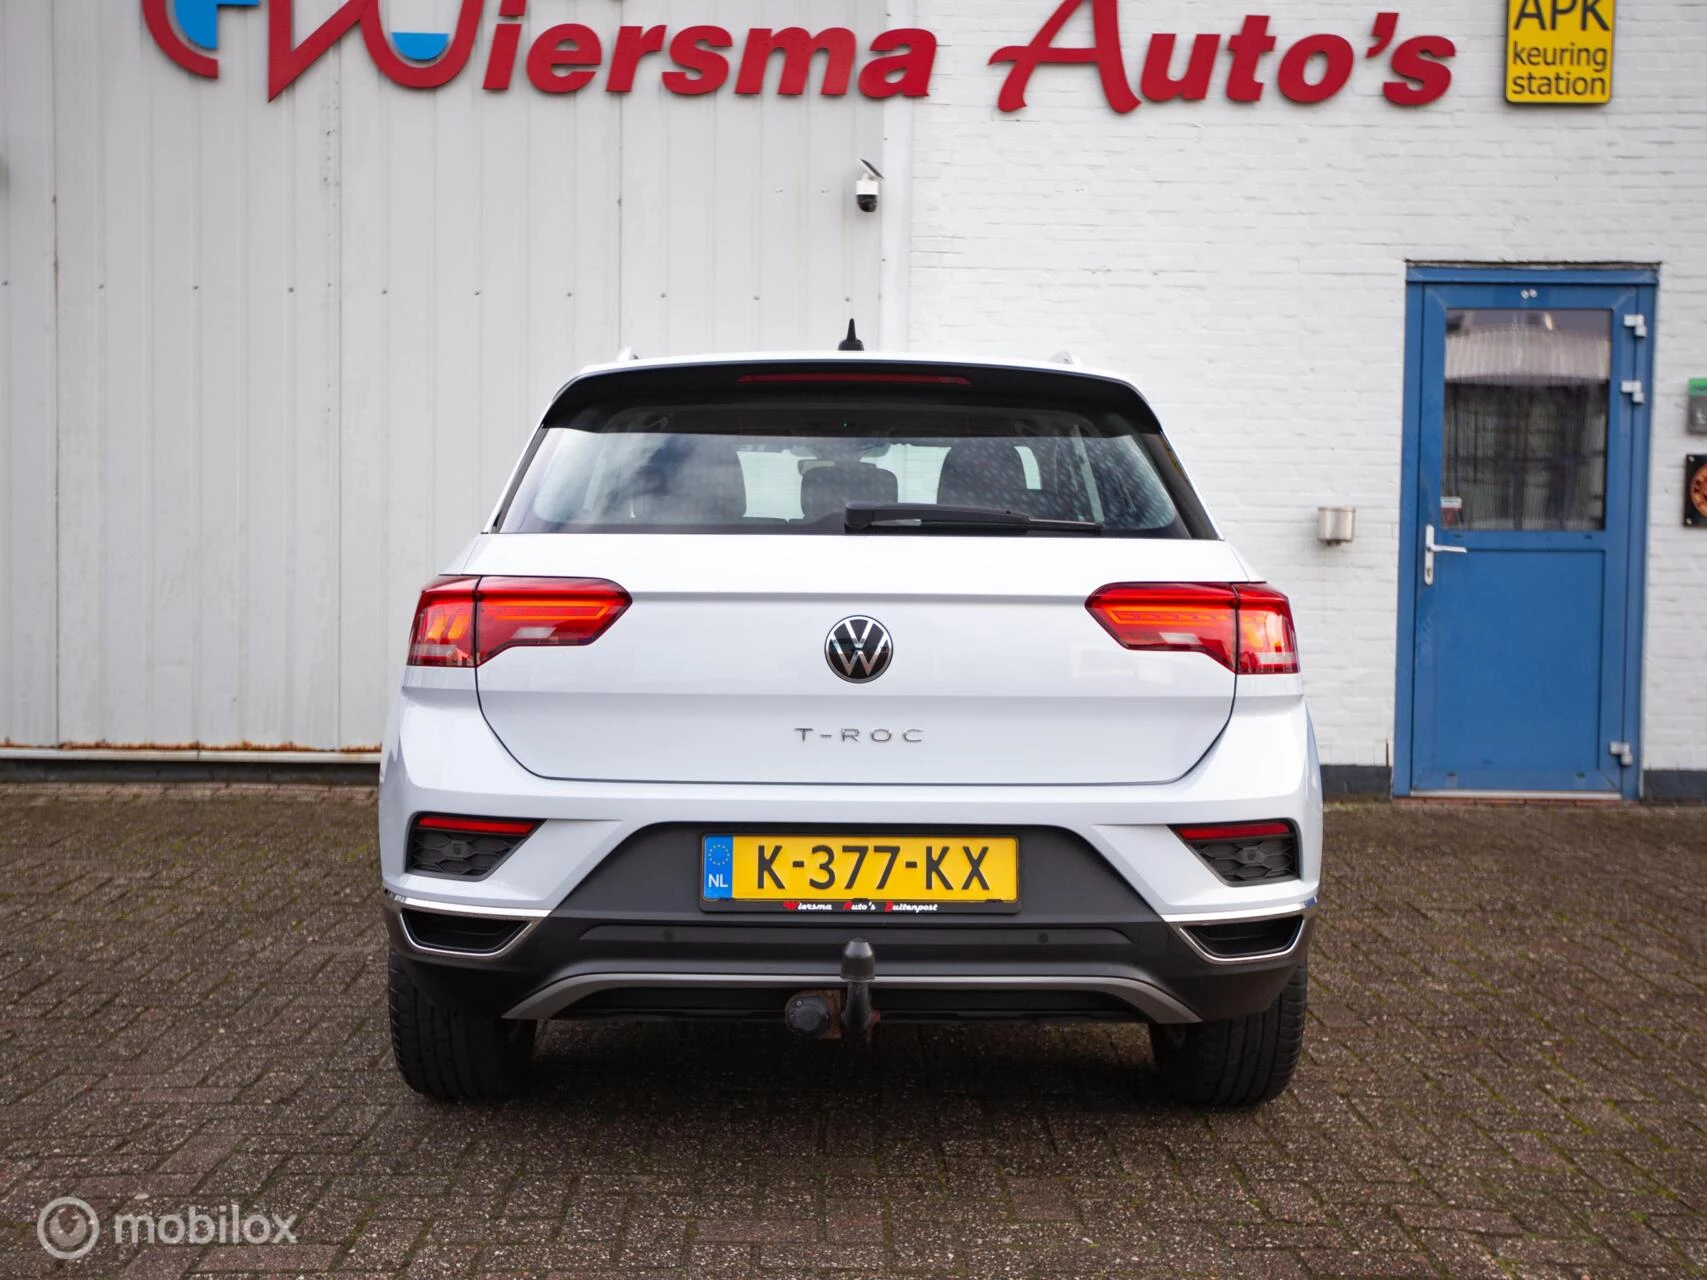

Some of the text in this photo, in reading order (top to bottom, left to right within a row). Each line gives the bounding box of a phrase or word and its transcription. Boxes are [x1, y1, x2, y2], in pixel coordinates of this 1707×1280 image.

[1513, 0, 1610, 31] APK
[987, 0, 1457, 112] Auto's
[1512, 40, 1608, 73] keuring
[1512, 71, 1606, 96] station
[794, 727, 924, 743] T-ROC
[708, 873, 729, 888] NL
[756, 844, 991, 891] K-377-KX
[843, 900, 876, 911] Auto's
